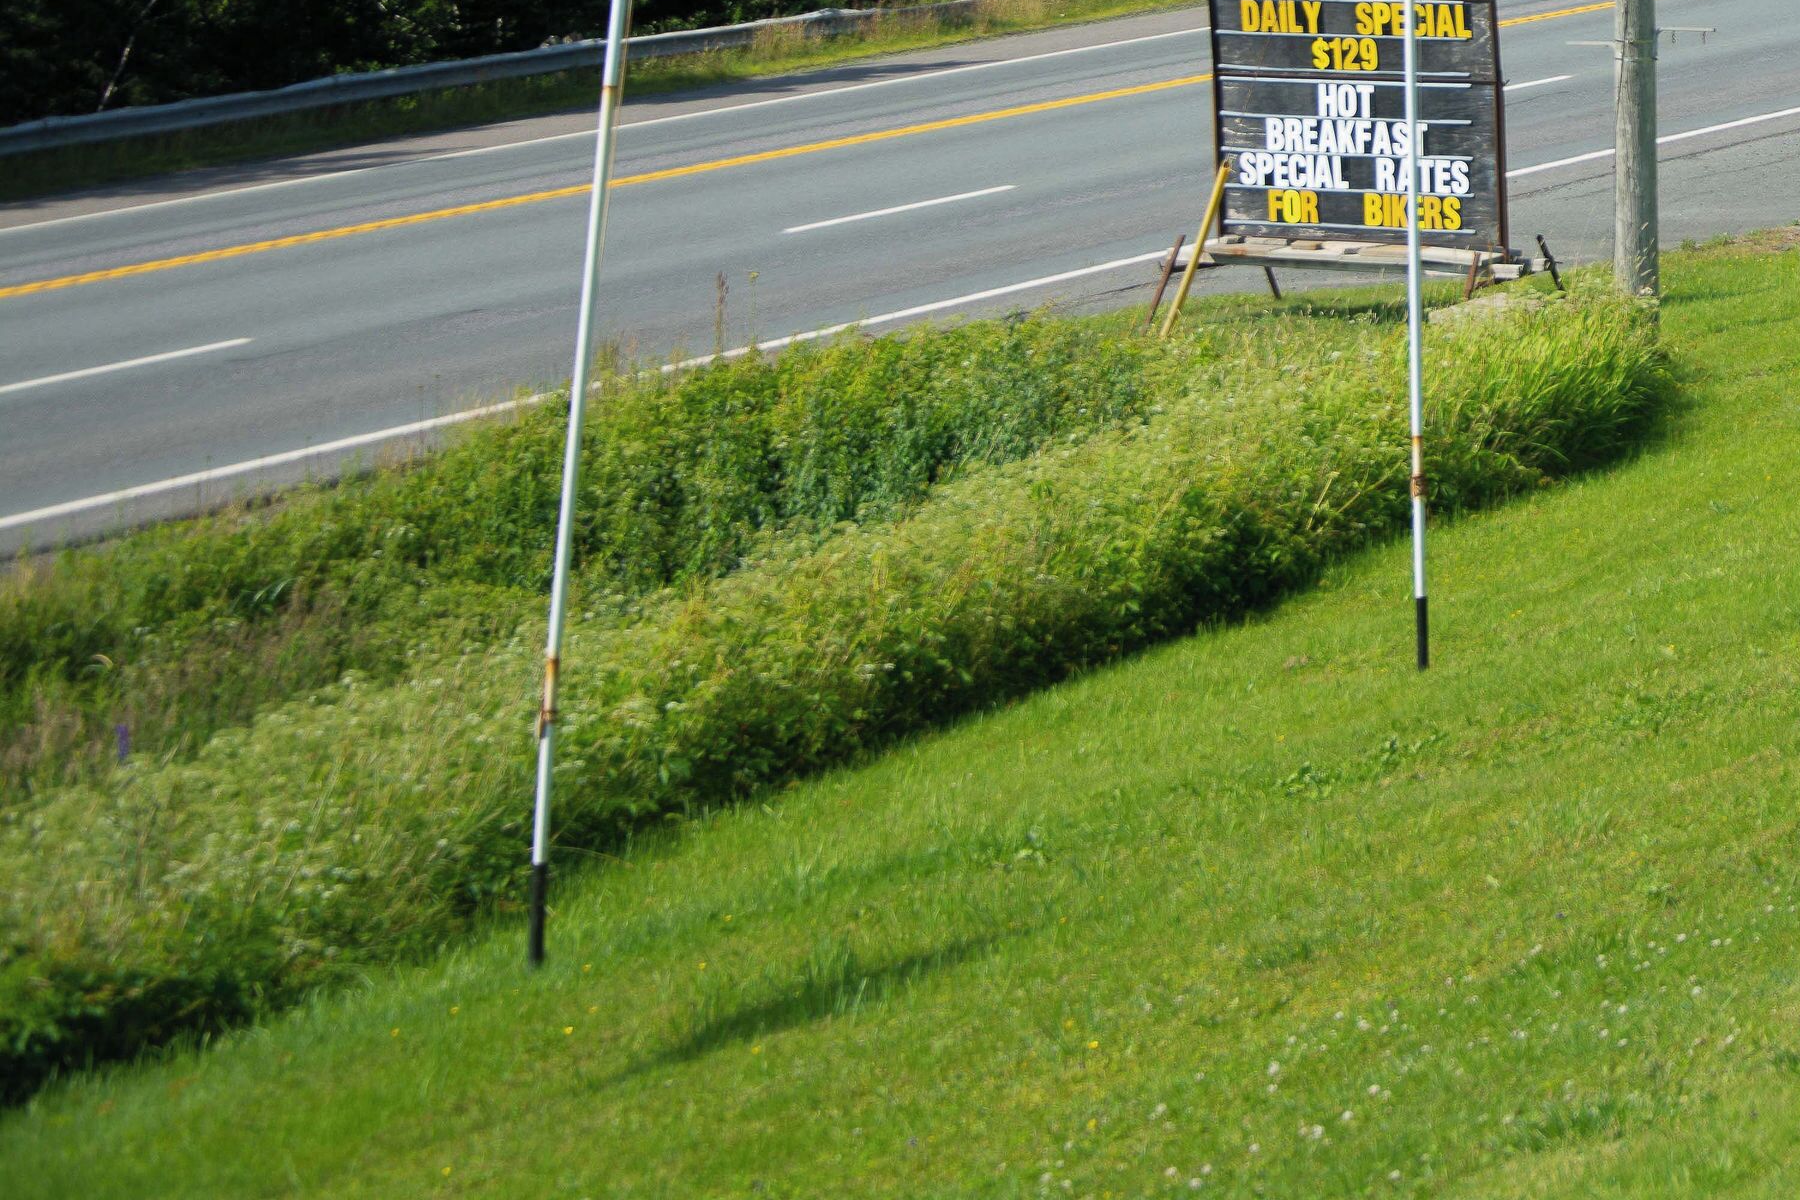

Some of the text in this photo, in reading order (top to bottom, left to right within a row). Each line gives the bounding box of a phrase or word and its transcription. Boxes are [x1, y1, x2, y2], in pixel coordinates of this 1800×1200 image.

[1240, 0, 1473, 39] DAILY SPECIAL
[1311, 36, 1379, 71] $129
[1318, 84, 1375, 118] HOT
[1266, 117, 1428, 157] BREAKFAST
[1240, 152, 1470, 195] SPECIAL RATES
[1267, 189, 1319, 224] FOR
